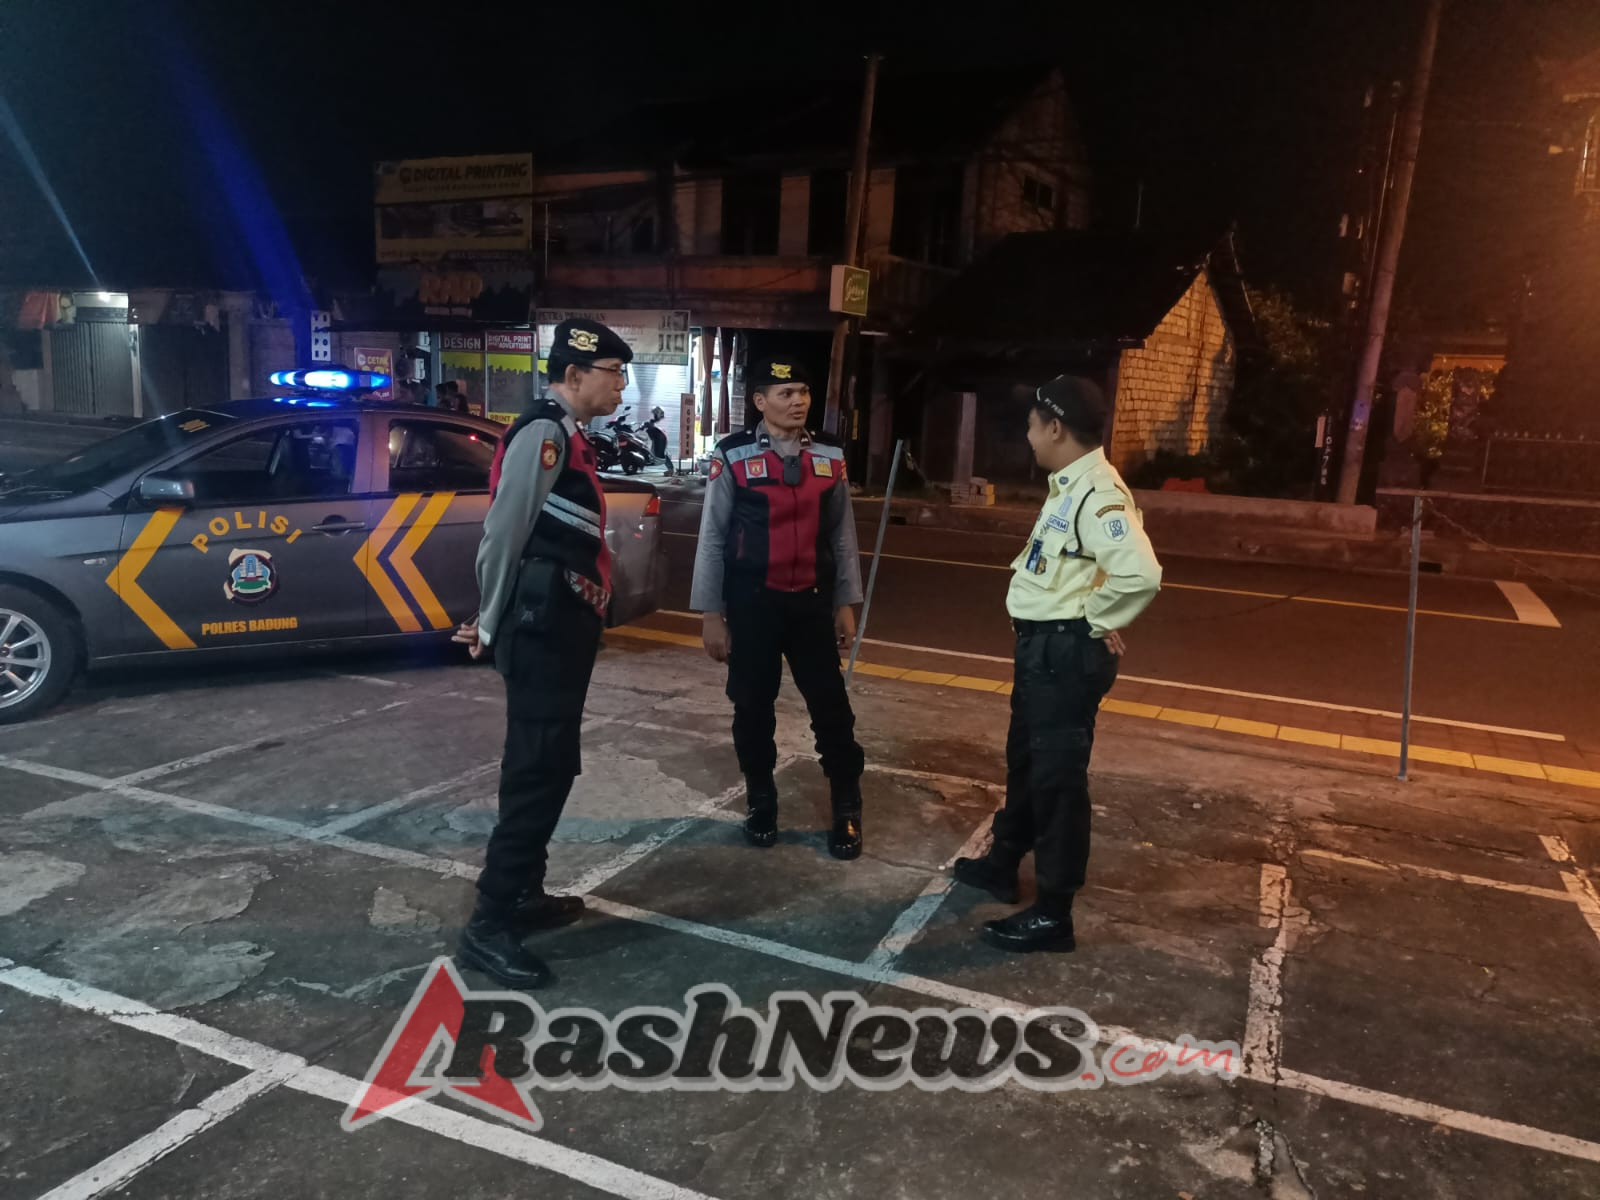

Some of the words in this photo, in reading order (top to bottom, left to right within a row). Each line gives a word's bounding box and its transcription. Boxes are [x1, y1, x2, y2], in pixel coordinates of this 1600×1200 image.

[413, 167, 461, 182] DIGITAL
[464, 162, 528, 179] PRINTING
[443, 336, 481, 350] DESIGN
[488, 335, 512, 344] DIGITAL
[513, 335, 532, 344] PRINT
[191, 511, 303, 554] POLISI
[201, 620, 247, 636] POLRES
[249, 617, 298, 632] BADUNG
